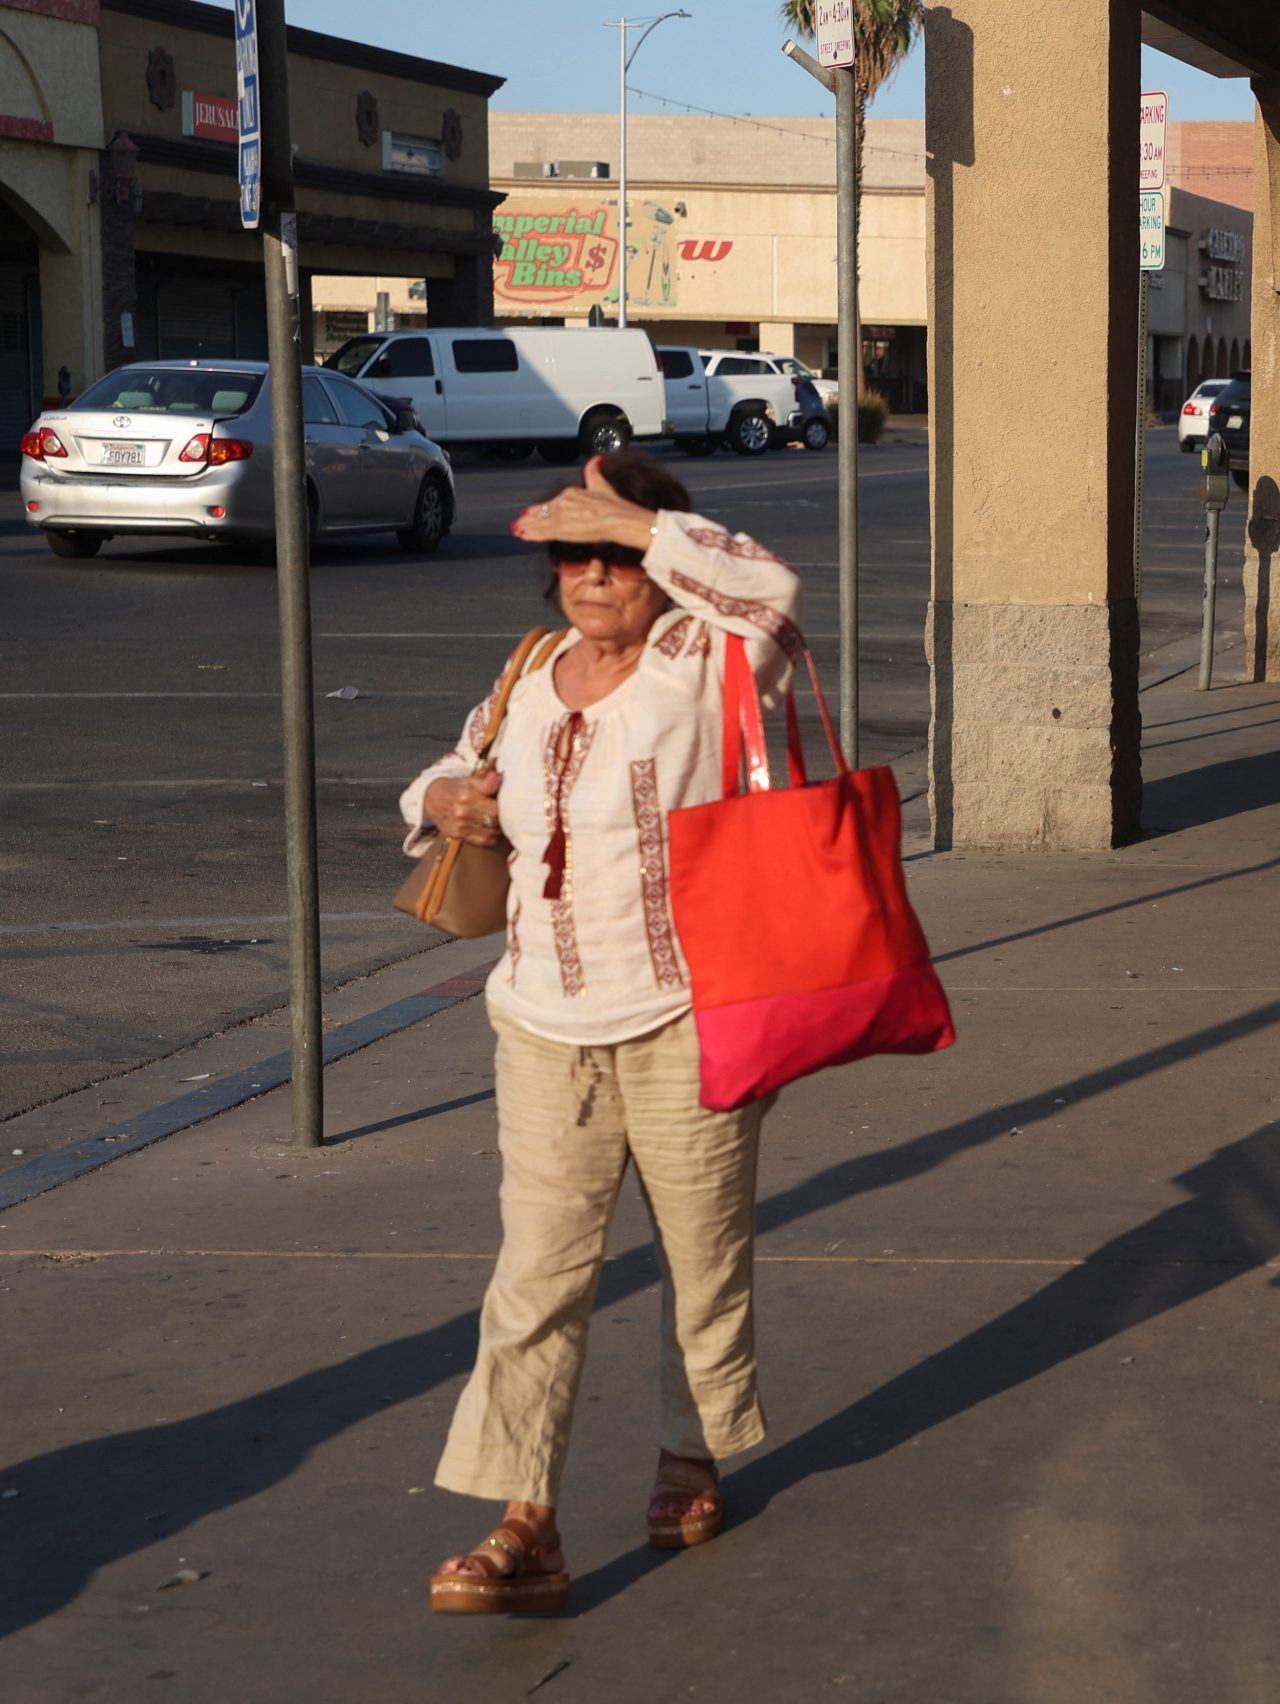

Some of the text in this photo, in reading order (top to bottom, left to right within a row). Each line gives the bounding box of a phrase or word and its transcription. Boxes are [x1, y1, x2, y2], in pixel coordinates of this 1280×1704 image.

[1140, 105, 1164, 124] ARKING
[1141, 142, 1162, 160] :30 AM
[1140, 169, 1158, 180] WEEPING
[492, 210, 605, 238] mperial
[500, 233, 570, 267] alley
[1142, 241, 1160, 259] 6 PM
[510, 262, 582, 287] Bins
